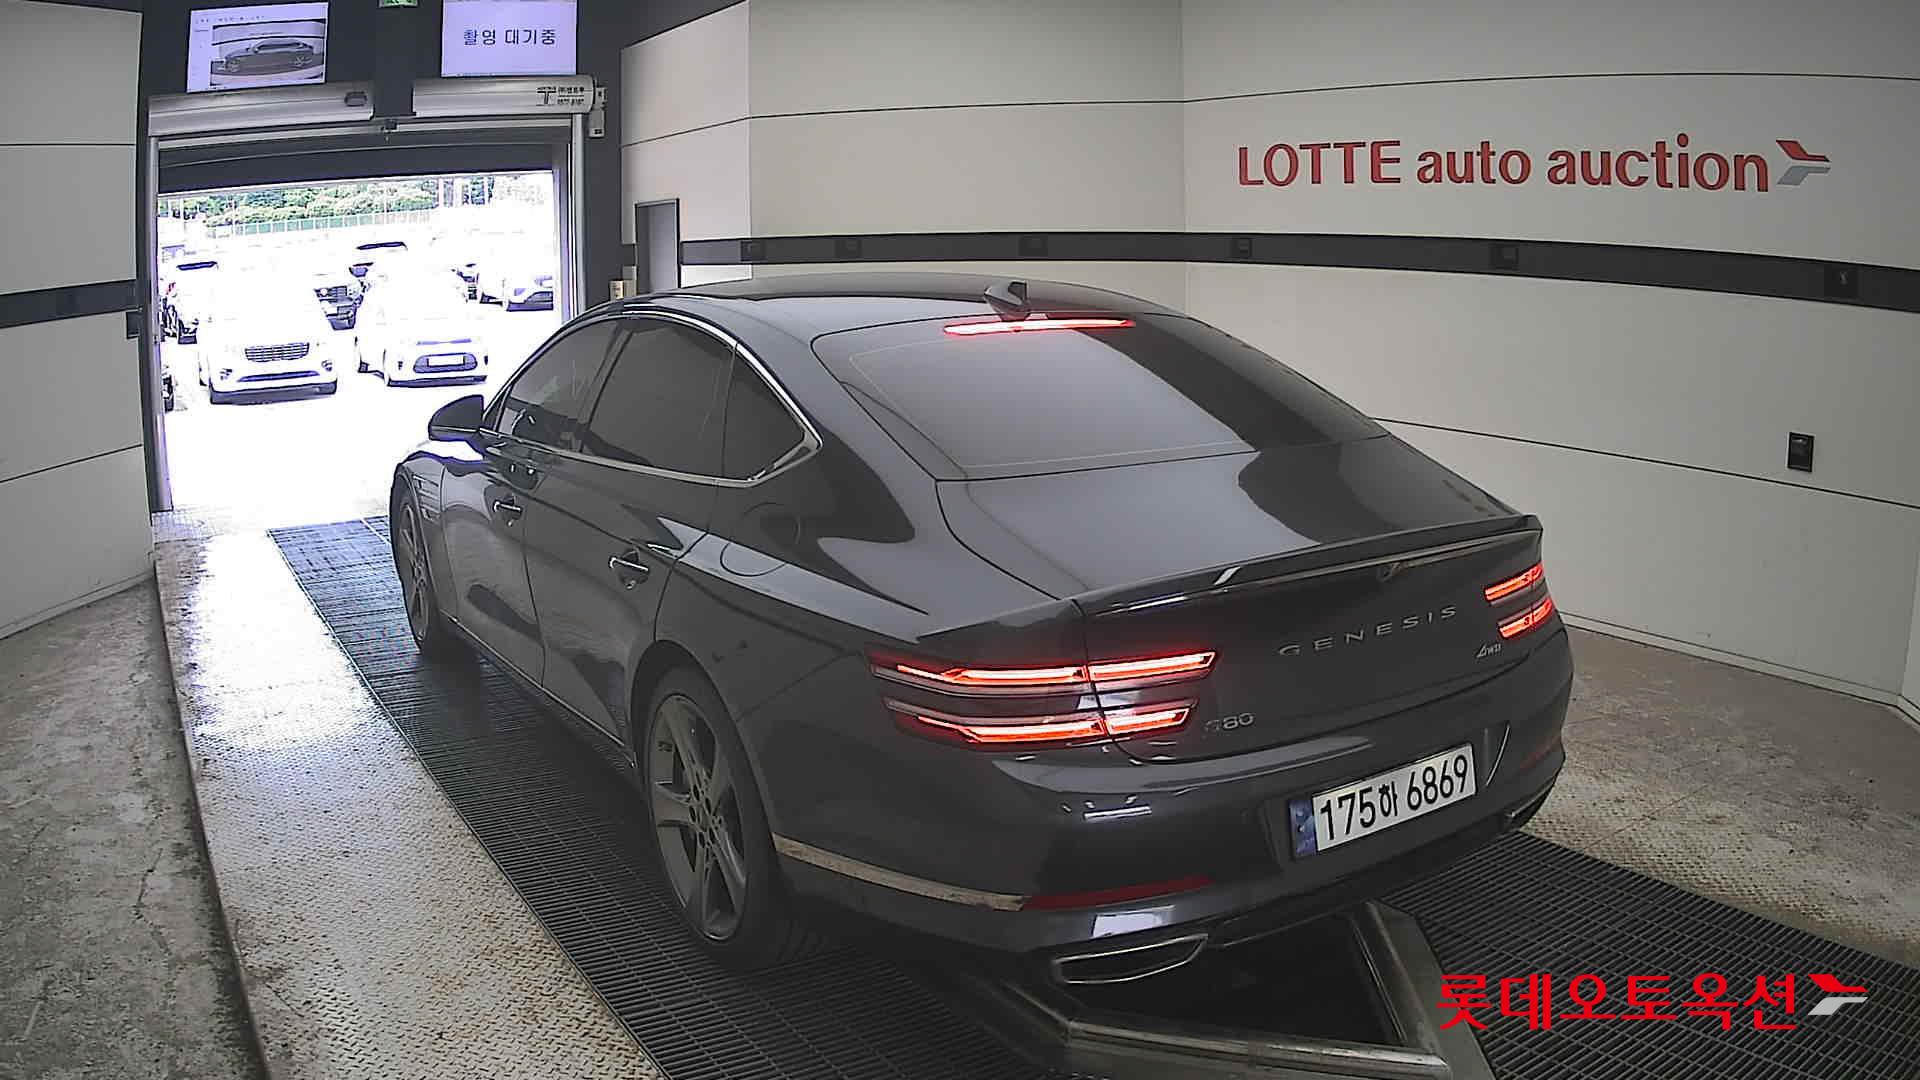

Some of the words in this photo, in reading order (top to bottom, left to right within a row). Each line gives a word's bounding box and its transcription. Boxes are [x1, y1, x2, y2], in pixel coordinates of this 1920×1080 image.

[504, 28, 556, 46] 대기중
[1238, 139, 1401, 187] LOTTE
[1416, 140, 1532, 184] auto
[1546, 132, 1769, 192] auction
[1279, 605, 1457, 656] GENESIS
[1320, 780, 1398, 840] 175하
[1407, 754, 1468, 811] 6869
